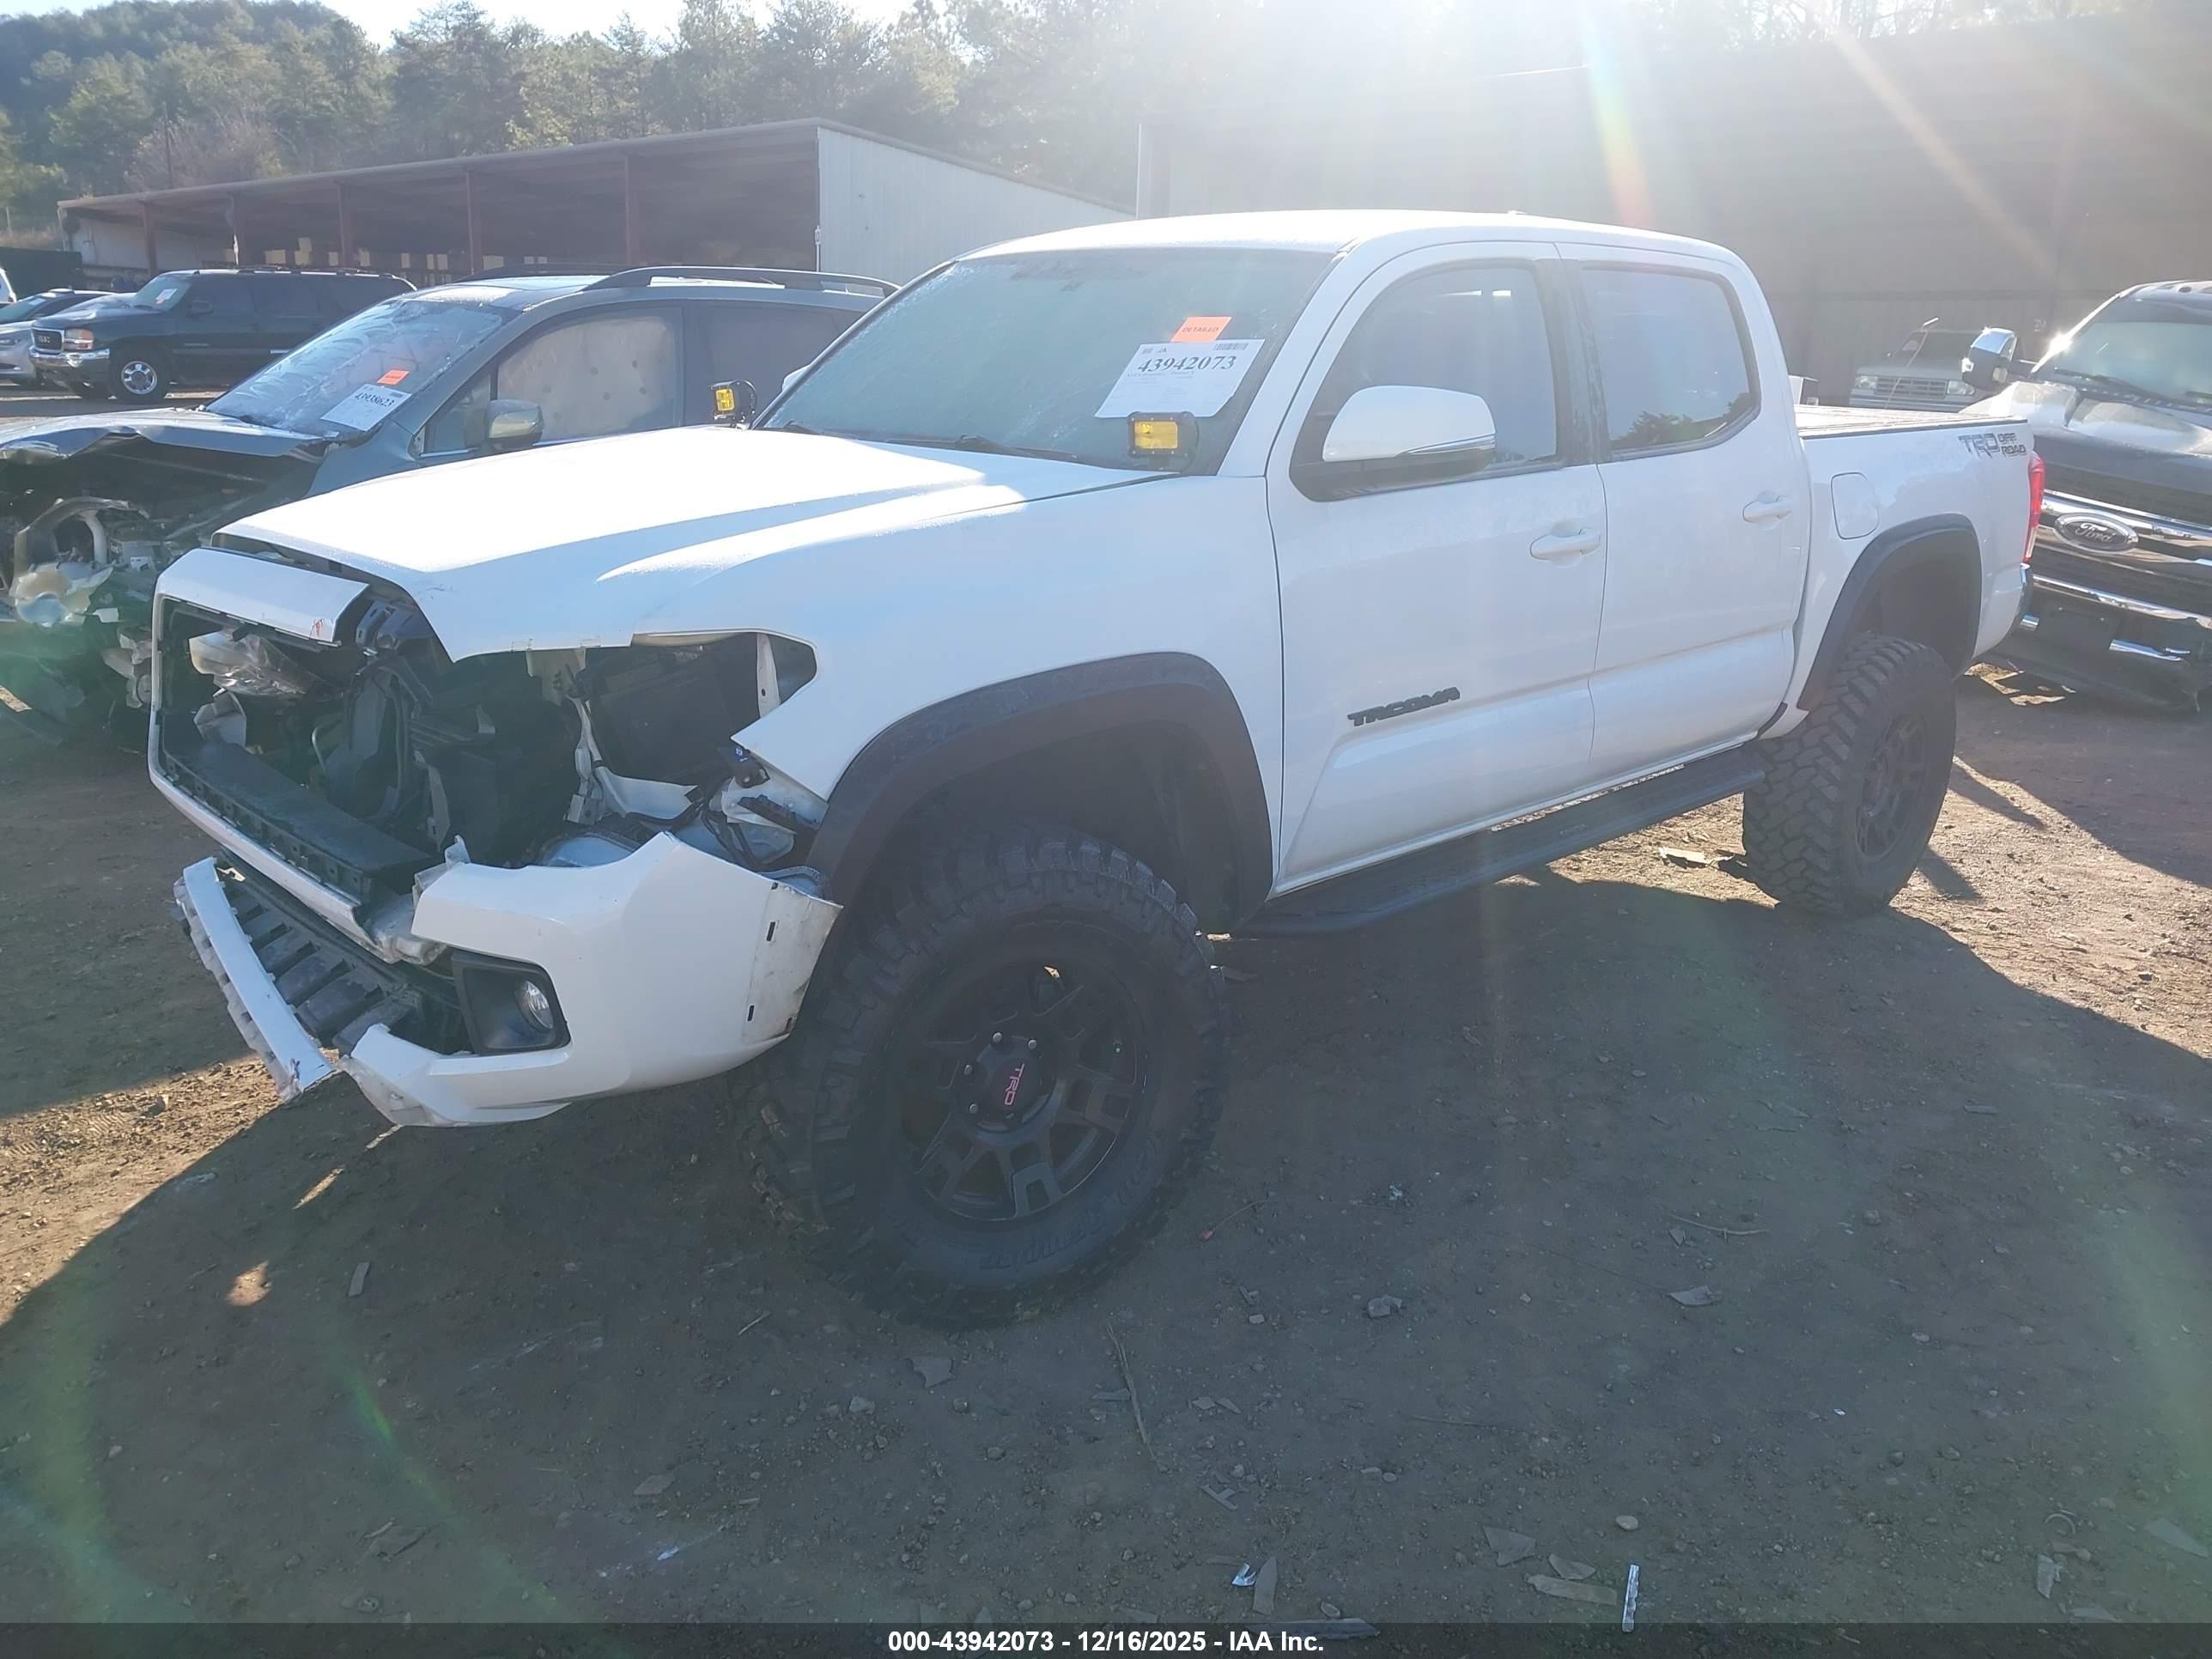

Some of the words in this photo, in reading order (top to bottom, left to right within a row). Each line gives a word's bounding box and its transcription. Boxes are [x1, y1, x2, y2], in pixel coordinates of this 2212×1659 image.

[1137, 356, 1237, 373] 43942073
[1958, 433, 2000, 459] TRD
[1997, 433, 2017, 444] OFF
[2001, 444, 2027, 457] ROAD
[2075, 522, 2116, 543] Ford
[1346, 686, 1461, 727] TACOMA
[1004, 1063, 1025, 1105] TRD
